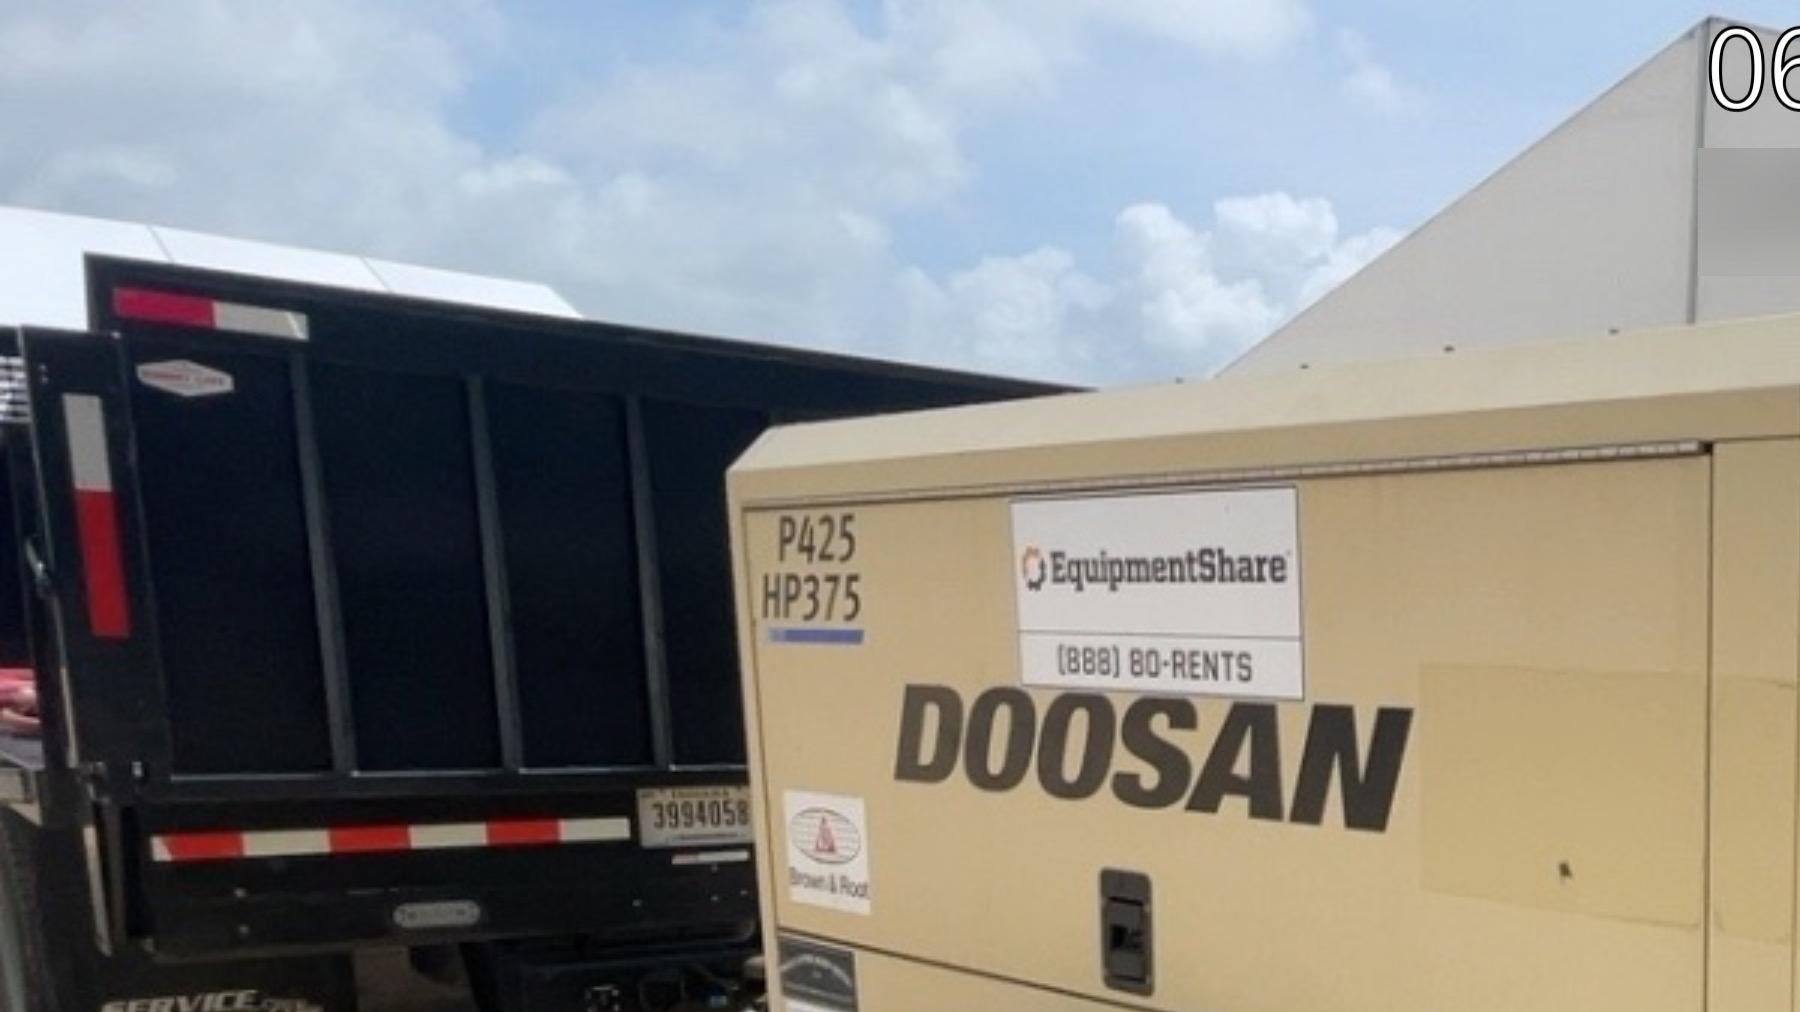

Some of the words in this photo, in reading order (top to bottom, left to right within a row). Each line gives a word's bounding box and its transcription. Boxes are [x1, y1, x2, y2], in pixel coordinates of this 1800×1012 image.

[778, 513, 856, 564] P425
[1050, 548, 1287, 592] EquipmentShare
[762, 572, 861, 622] HP375
[1057, 645, 1120, 678] (888)
[1130, 650, 1252, 682] 80-RENTS
[894, 684, 1414, 833] DOOSAN
[651, 798, 750, 829] 3994058
[788, 866, 826, 890] Brown
